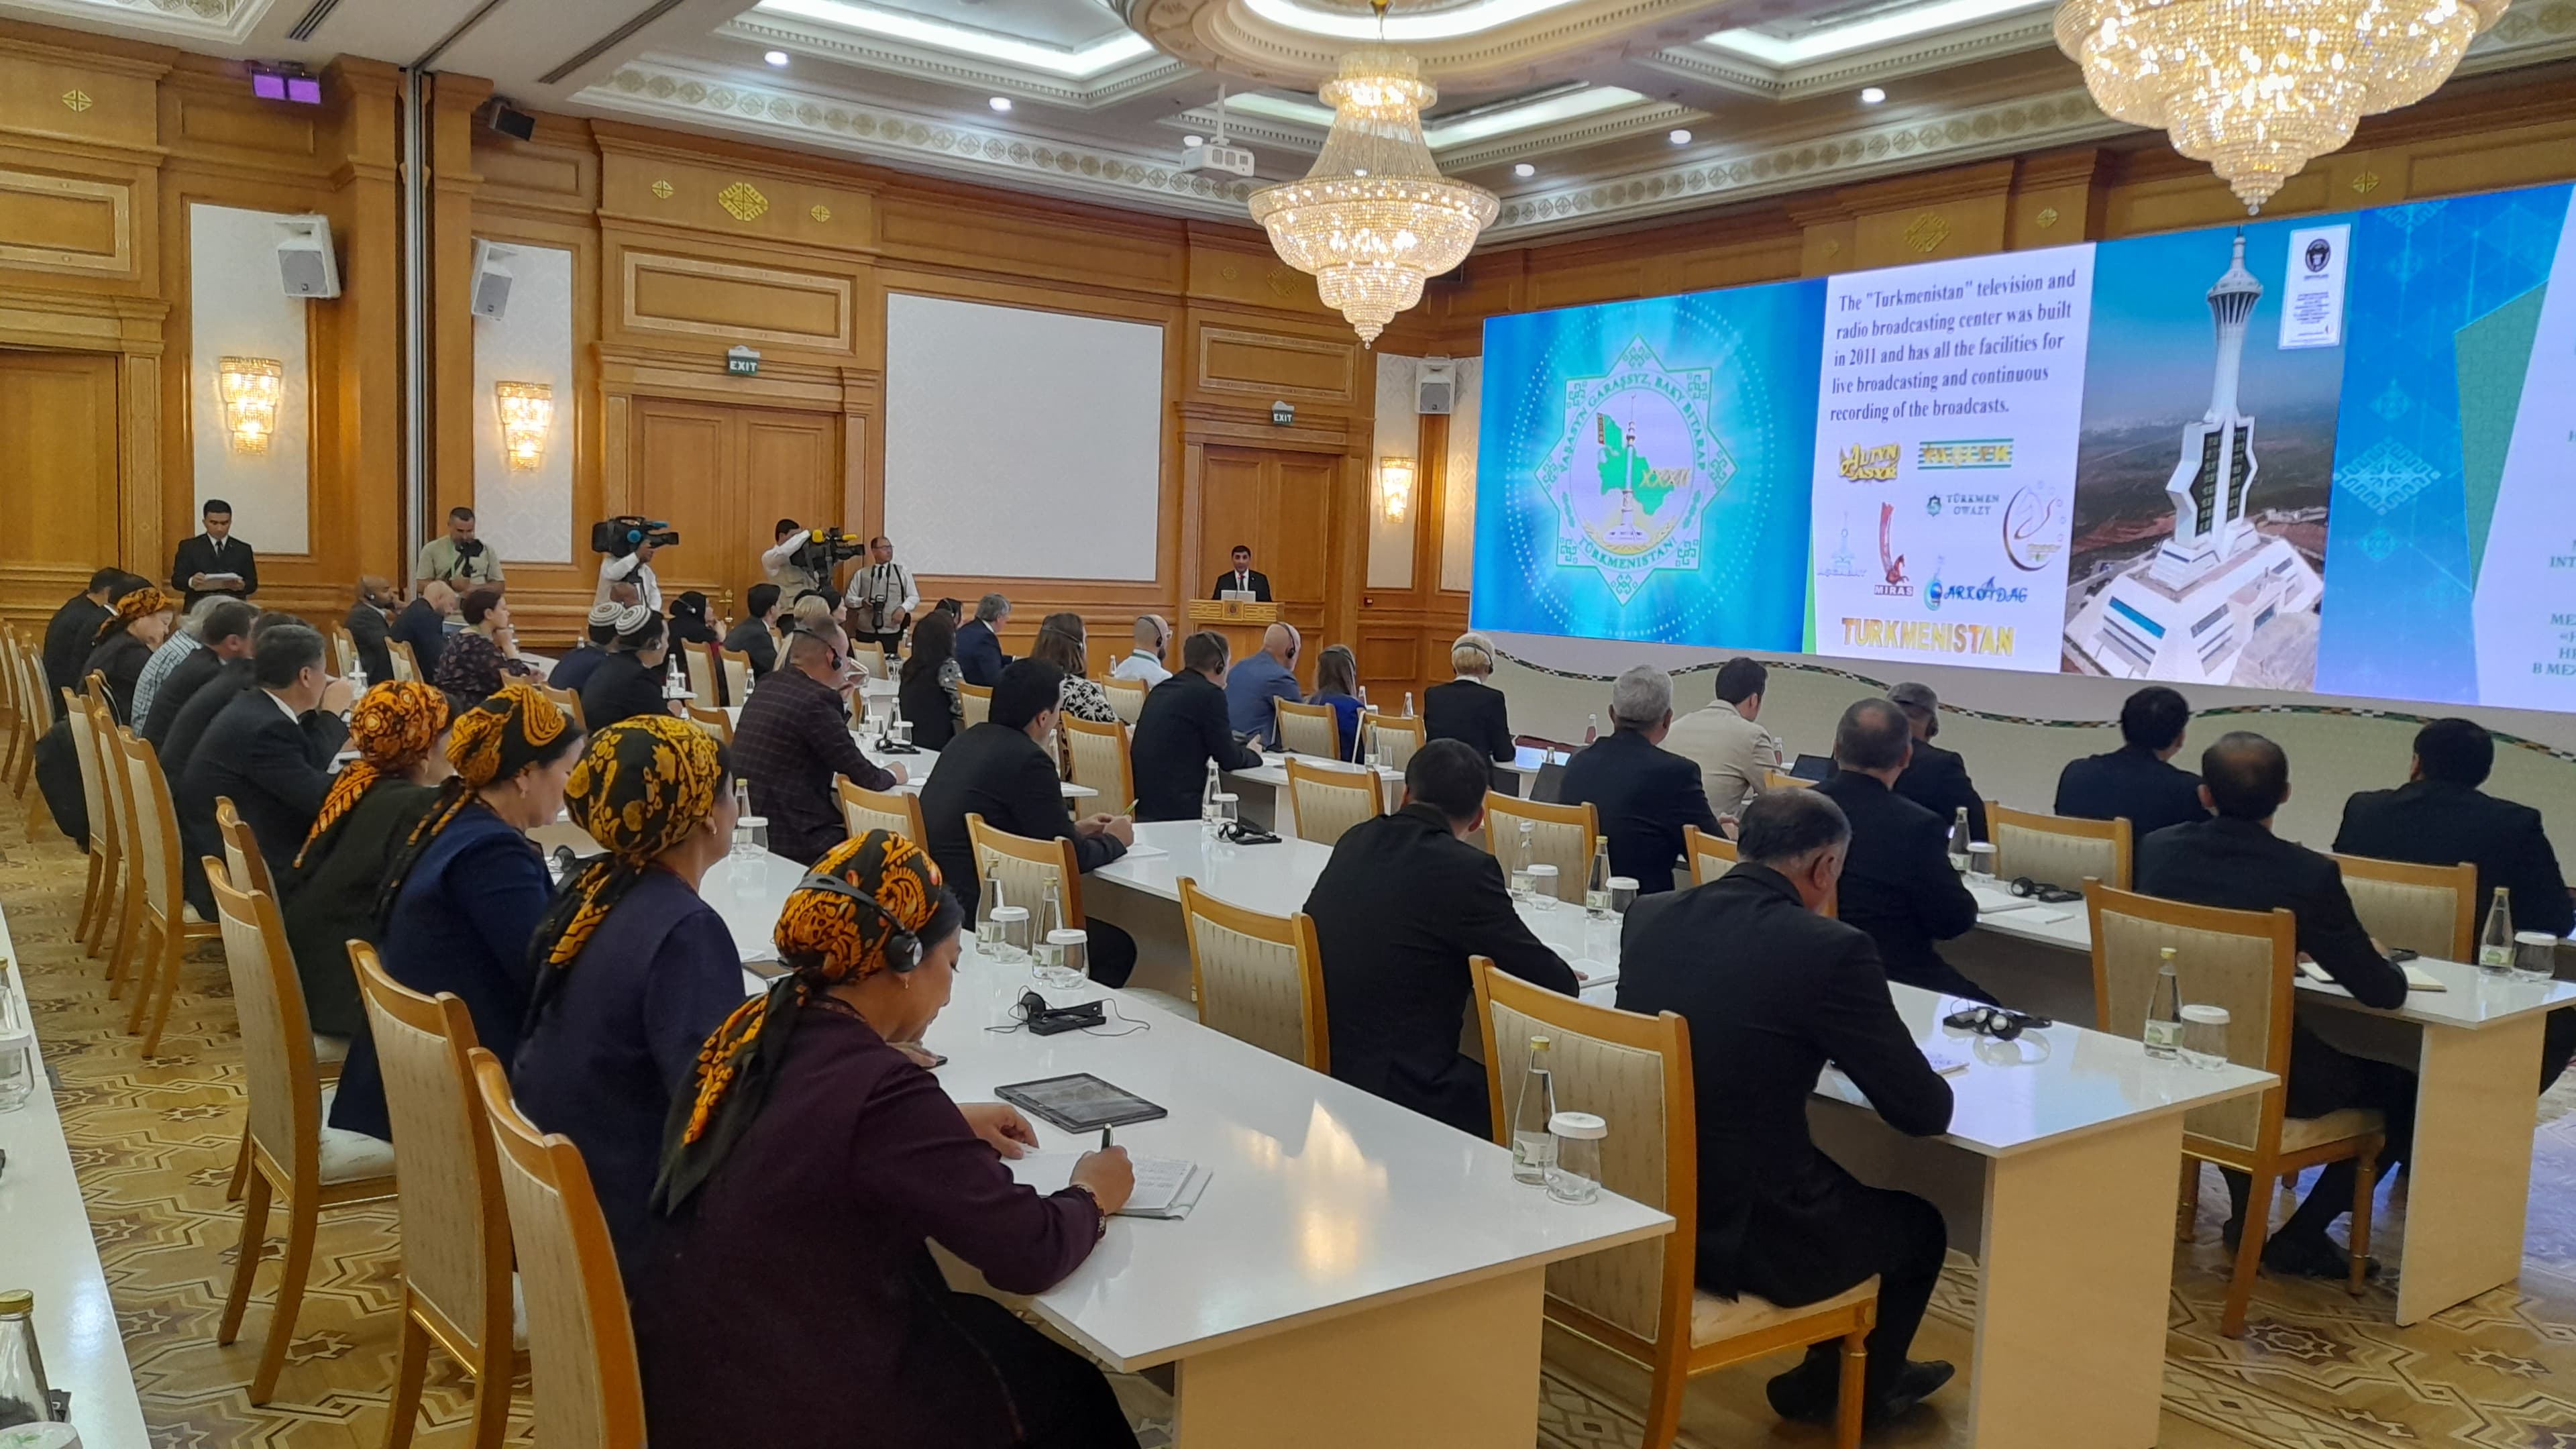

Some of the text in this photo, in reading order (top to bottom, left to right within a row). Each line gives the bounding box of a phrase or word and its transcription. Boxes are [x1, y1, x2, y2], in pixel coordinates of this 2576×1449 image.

[1839, 268, 2076, 312] The "Turkmenistan" television and
[1836, 300, 2072, 339] radio broadcasting center was built
[1834, 332, 2065, 366] in 2011 and has all the facilities for
[729, 360, 757, 372] EXIT
[1832, 365, 2049, 394] live broadcasting and continuous
[1273, 413, 1292, 422] EXIT
[1830, 396, 2010, 423] recording of the broadcasts.
[1875, 586, 1913, 596] MIRAS
[1842, 617, 2013, 655] TURKMENISTAN
